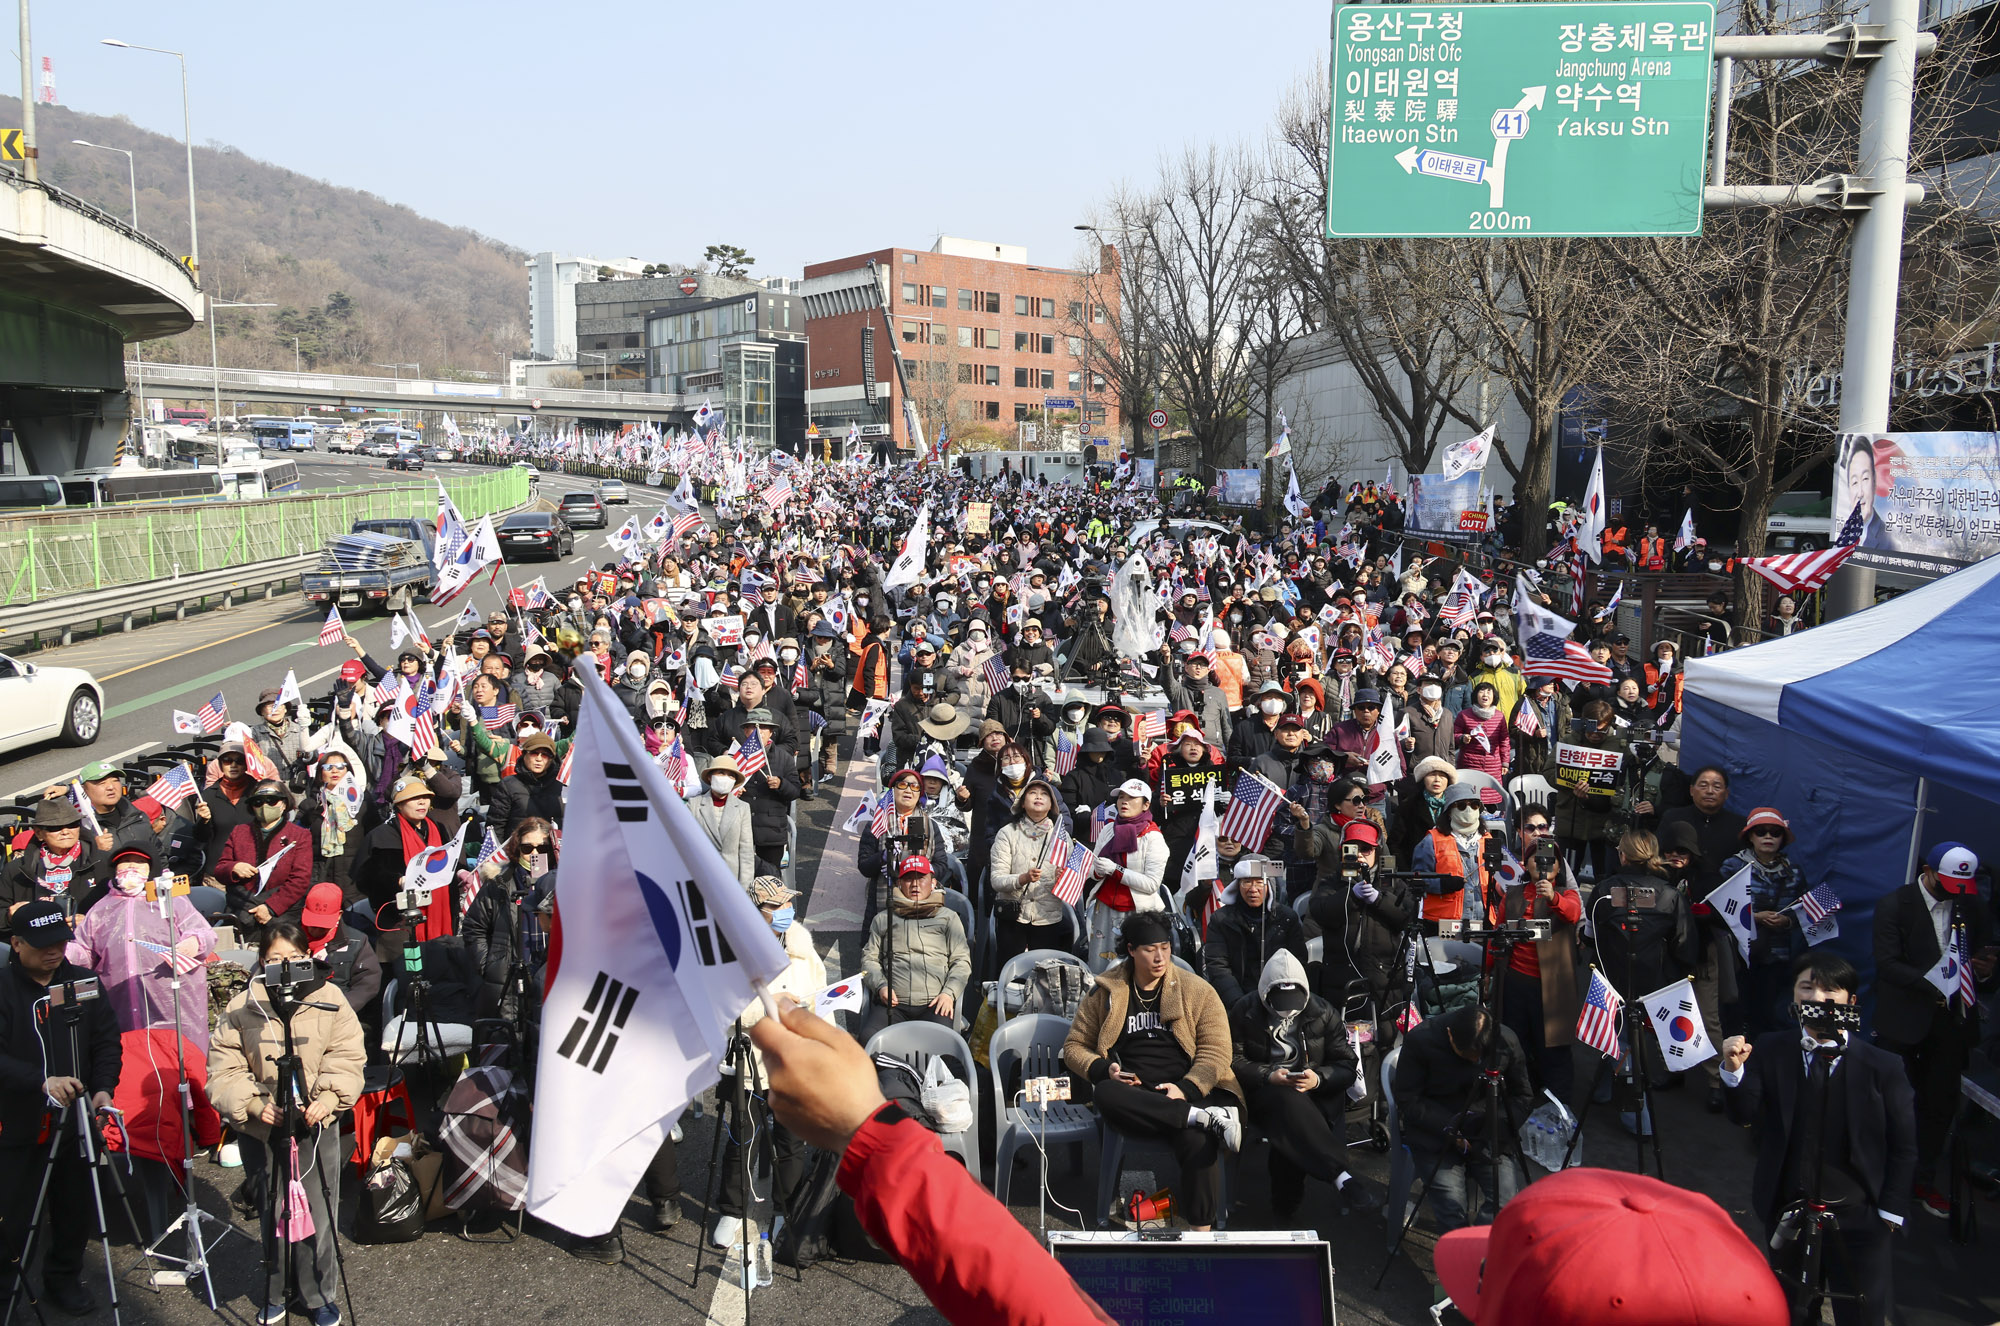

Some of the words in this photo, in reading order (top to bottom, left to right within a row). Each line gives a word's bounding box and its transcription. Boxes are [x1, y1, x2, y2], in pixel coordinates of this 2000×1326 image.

[1347, 12, 1463, 42] 용산구청
[1558, 22, 1708, 53] 장충체육관
[1346, 44, 1404, 66] Yongsan
[1408, 44, 1435, 62] Dist
[1438, 43, 1462, 62] Ofc
[1556, 58, 1627, 82] Jangchung
[1631, 58, 1672, 77] Arena
[1346, 68, 1459, 97] 이태원역
[1555, 82, 1642, 112] 약수역
[1345, 99, 1458, 123] 梨泰院驛
[1341, 125, 1419, 143] Itaewon
[1425, 125, 1459, 143] Stn
[1496, 113, 1524, 135] 41
[1557, 118, 1624, 137] Yaksu
[1631, 117, 1670, 136] Stn
[1427, 155, 1478, 177] 이태원로
[1469, 210, 1531, 231] 200m
[1152, 415, 1164, 424] 60
[1888, 485, 1945, 509] 자유민주주의
[1947, 488, 2000, 512] 대한민국의
[1461, 520, 1484, 529] OUT!
[1468, 512, 1487, 520] CHINA
[1885, 512, 1913, 534] 윤석열
[1914, 514, 1966, 539] 대통령님의
[720, 635, 742, 644] FRE
[1560, 749, 1618, 768] 탄핵무효
[1170, 771, 1222, 787] 돌아와요!
[1560, 767, 1590, 783] 이재명
[1590, 771, 1614, 784] 구속
[30, 912, 63, 927] 대한민국
[1079, 1276, 1119, 1293] 한민국
